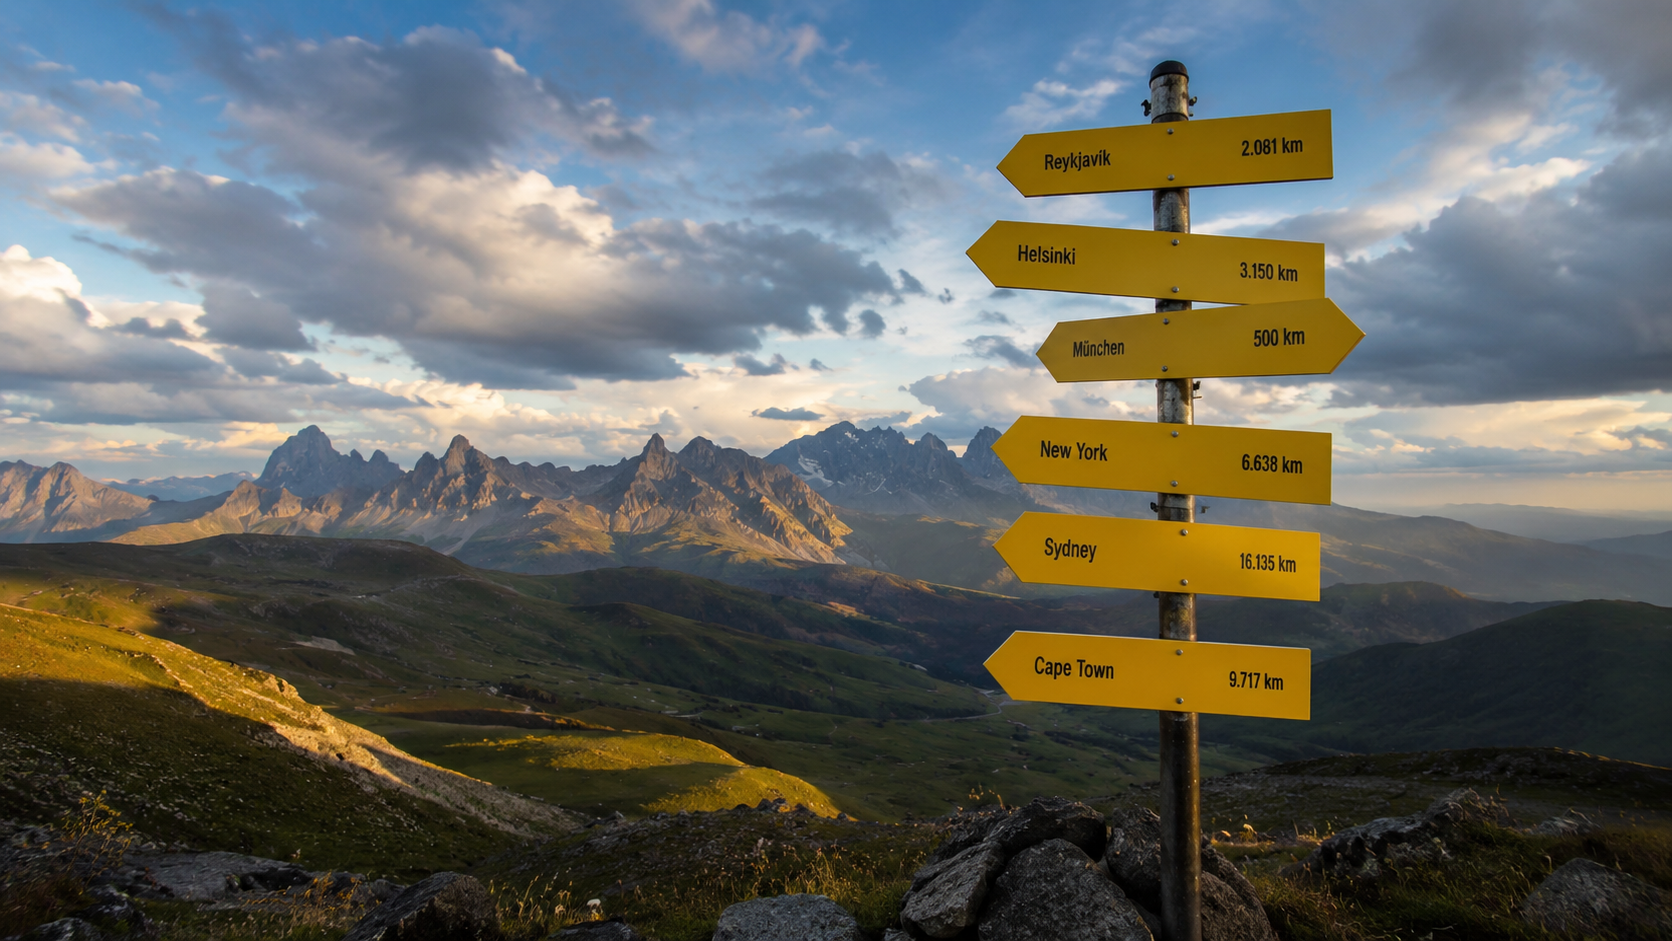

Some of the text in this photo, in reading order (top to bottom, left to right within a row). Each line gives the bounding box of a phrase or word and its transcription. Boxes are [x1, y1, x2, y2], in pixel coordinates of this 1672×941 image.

[1045, 137, 1303, 172] Reykjavík 2.081 km
[1018, 245, 1297, 282] Helsinki 3.150 km
[1254, 329, 1278, 347] 500
[1283, 328, 1304, 345] km
[1041, 440, 1302, 474] New York 6.638 km
[1044, 537, 1296, 572] Sydney 16.135 km
[1035, 656, 1283, 690] Cape Town 9.717 km
